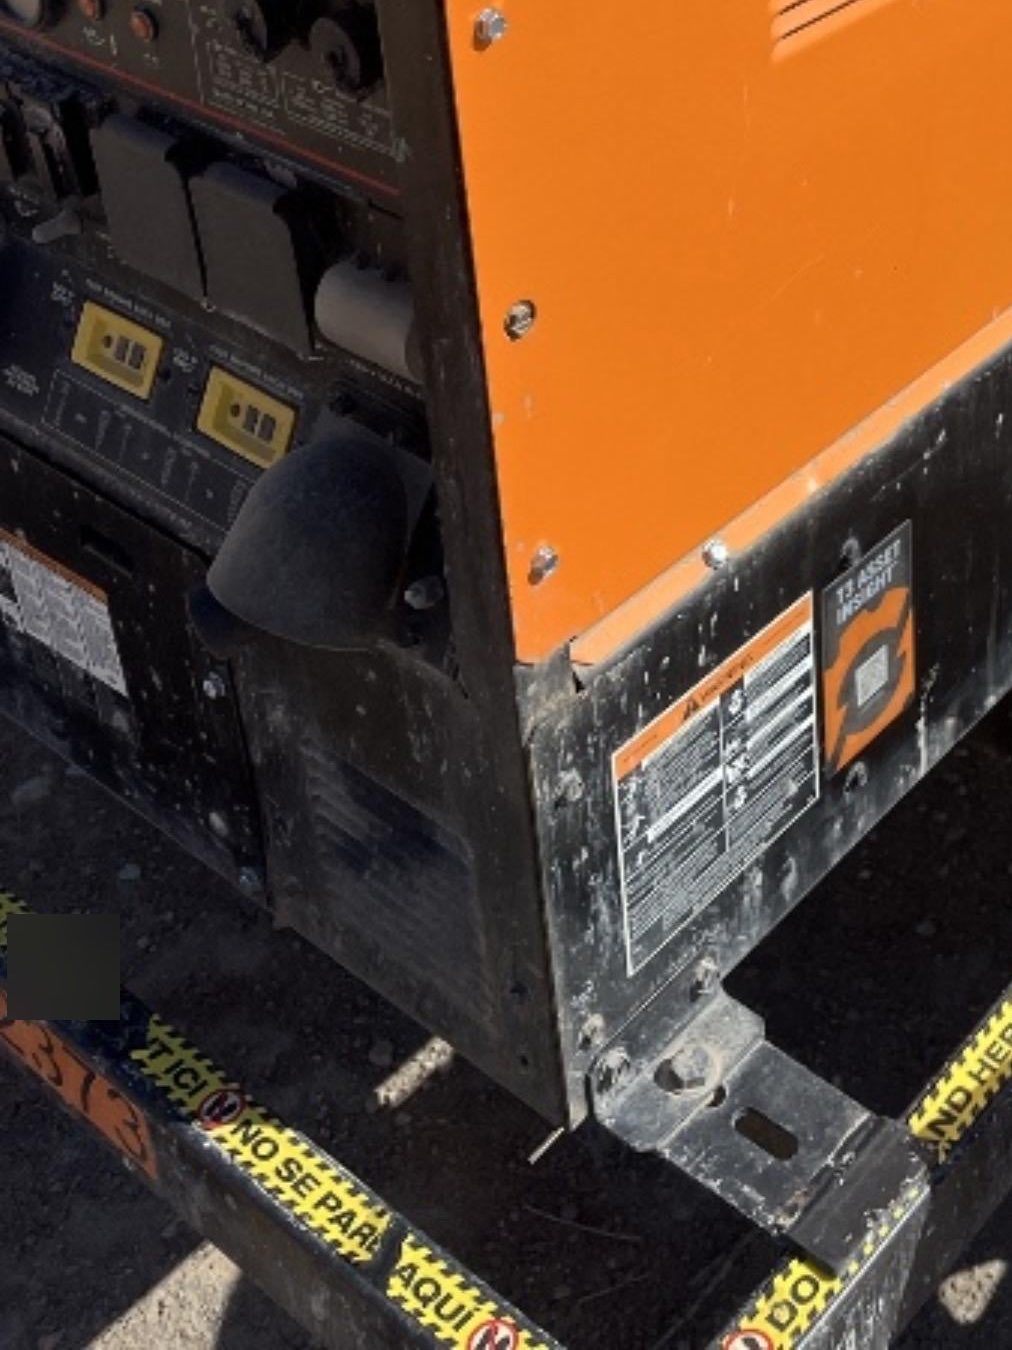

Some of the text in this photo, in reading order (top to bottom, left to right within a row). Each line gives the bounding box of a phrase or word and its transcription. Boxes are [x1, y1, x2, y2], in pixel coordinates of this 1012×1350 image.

[836, 560, 899, 626] INSIGHT
[856, 538, 902, 589] ASSET
[162, 1058, 209, 1099] ICI
[230, 1115, 280, 1162] NO
[274, 1153, 321, 1199] SE
[765, 1273, 821, 1334] DO
